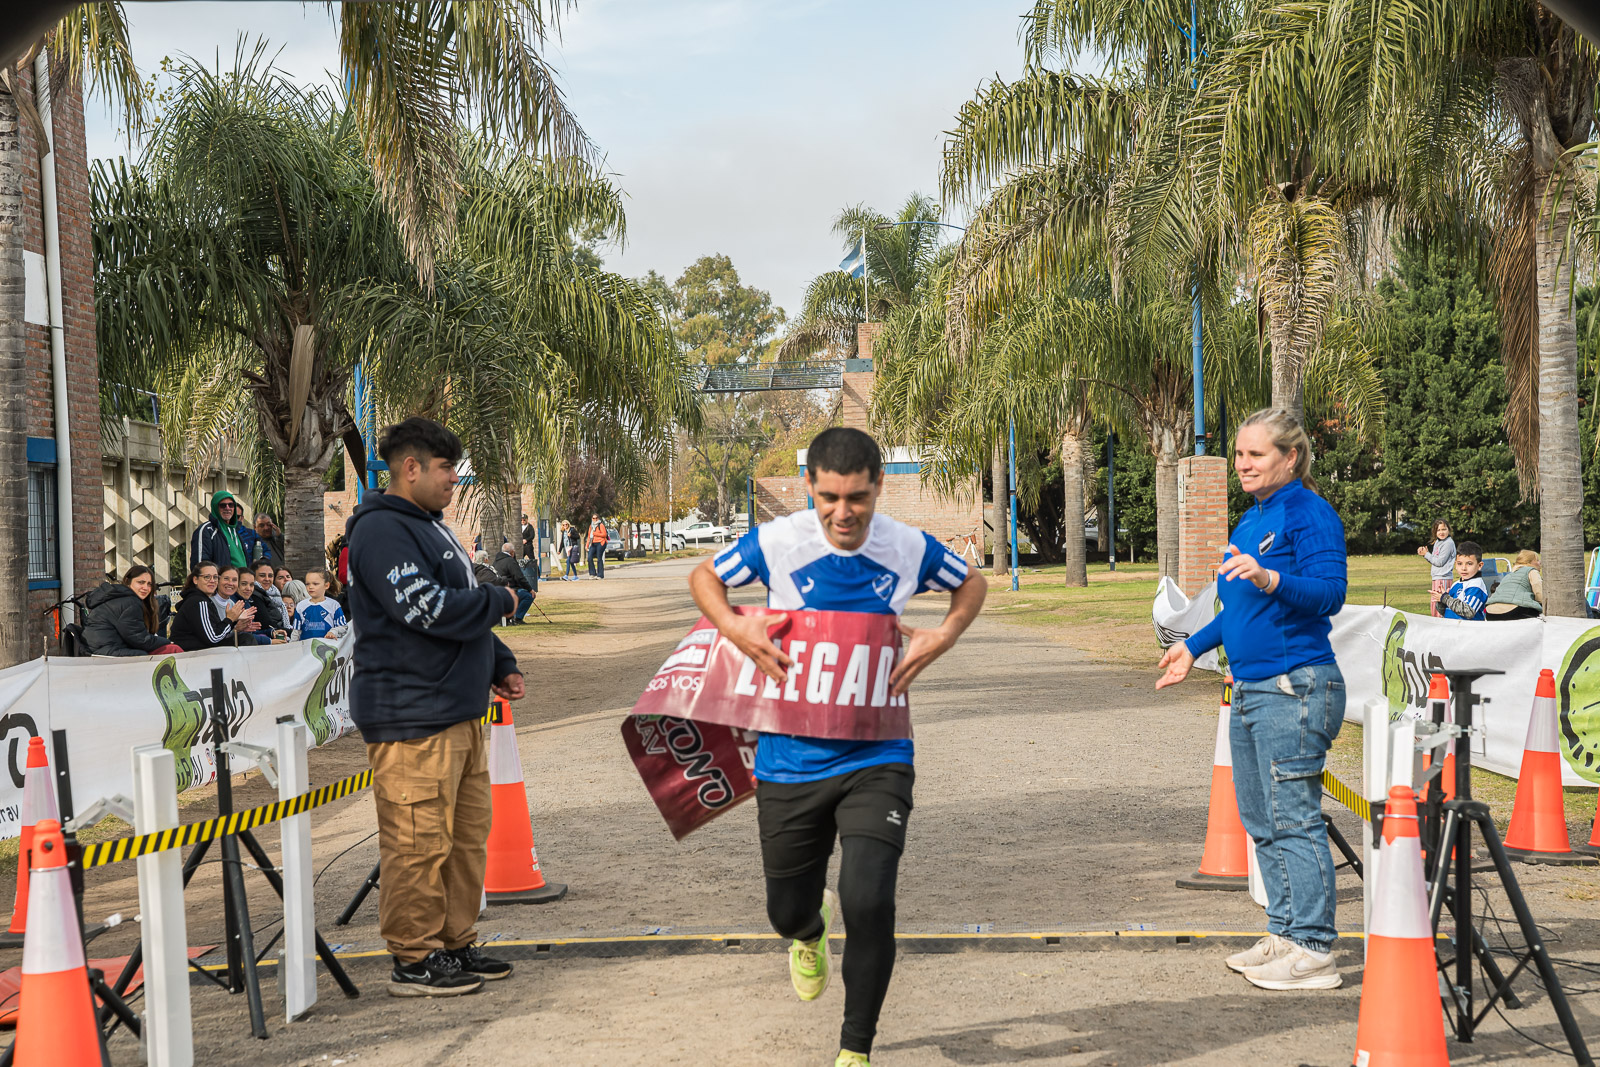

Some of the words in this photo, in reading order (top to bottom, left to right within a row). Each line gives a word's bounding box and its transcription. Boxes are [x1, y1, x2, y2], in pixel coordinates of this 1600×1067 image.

[401, 562, 419, 577] club
[395, 588, 405, 604] de
[671, 674, 702, 691] VOS
[0, 804, 19, 823] rav
